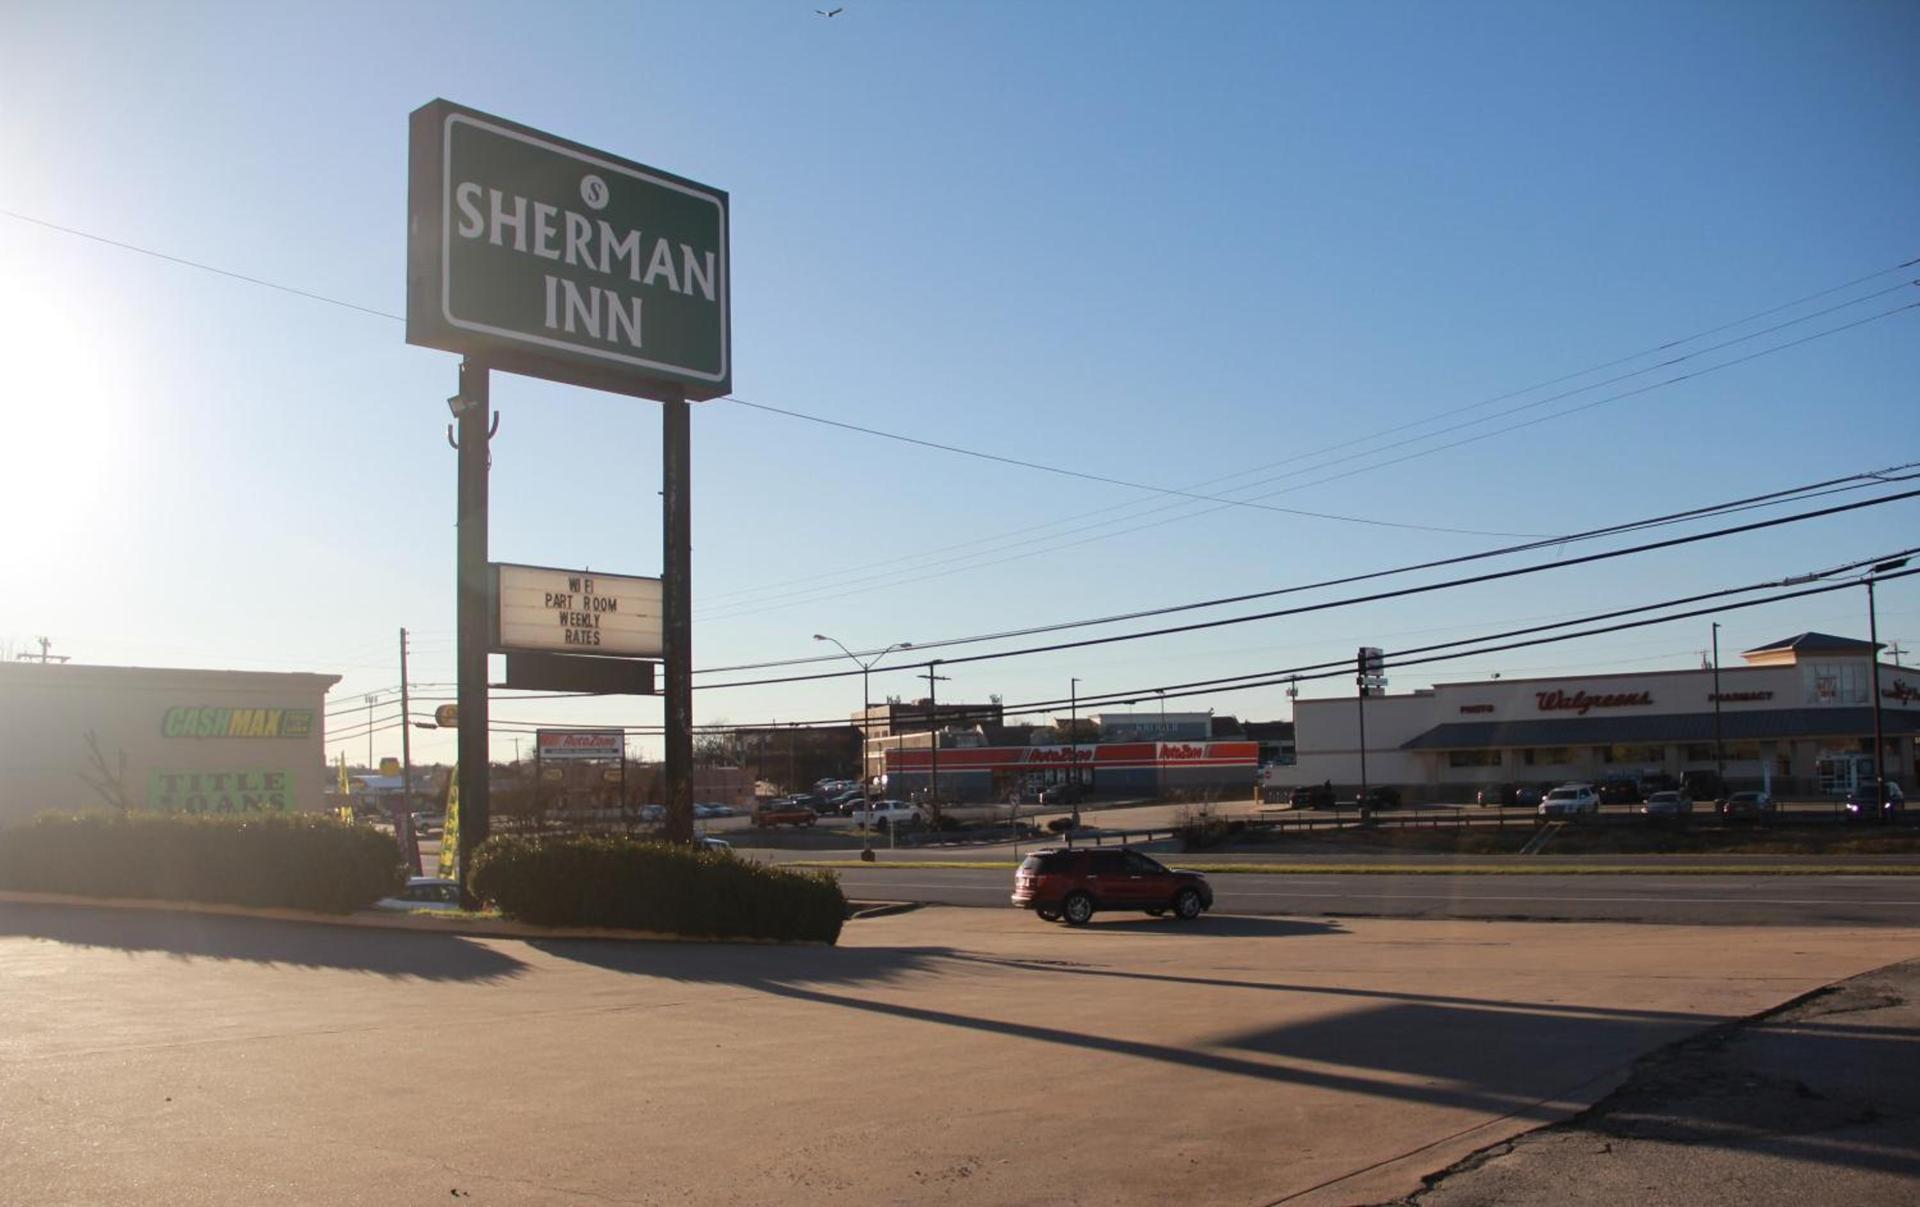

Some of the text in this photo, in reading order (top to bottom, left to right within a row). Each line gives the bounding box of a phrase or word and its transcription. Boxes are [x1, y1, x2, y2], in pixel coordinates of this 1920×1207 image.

[456, 181, 716, 302] SHERMAN
[544, 274, 643, 349] INN
[545, 592, 618, 613] PART ROOM
[559, 611, 601, 629] WEEKLY
[565, 628, 601, 646] RATES
[165, 707, 281, 736] CASHMAX
[158, 772, 286, 792] TITLE
